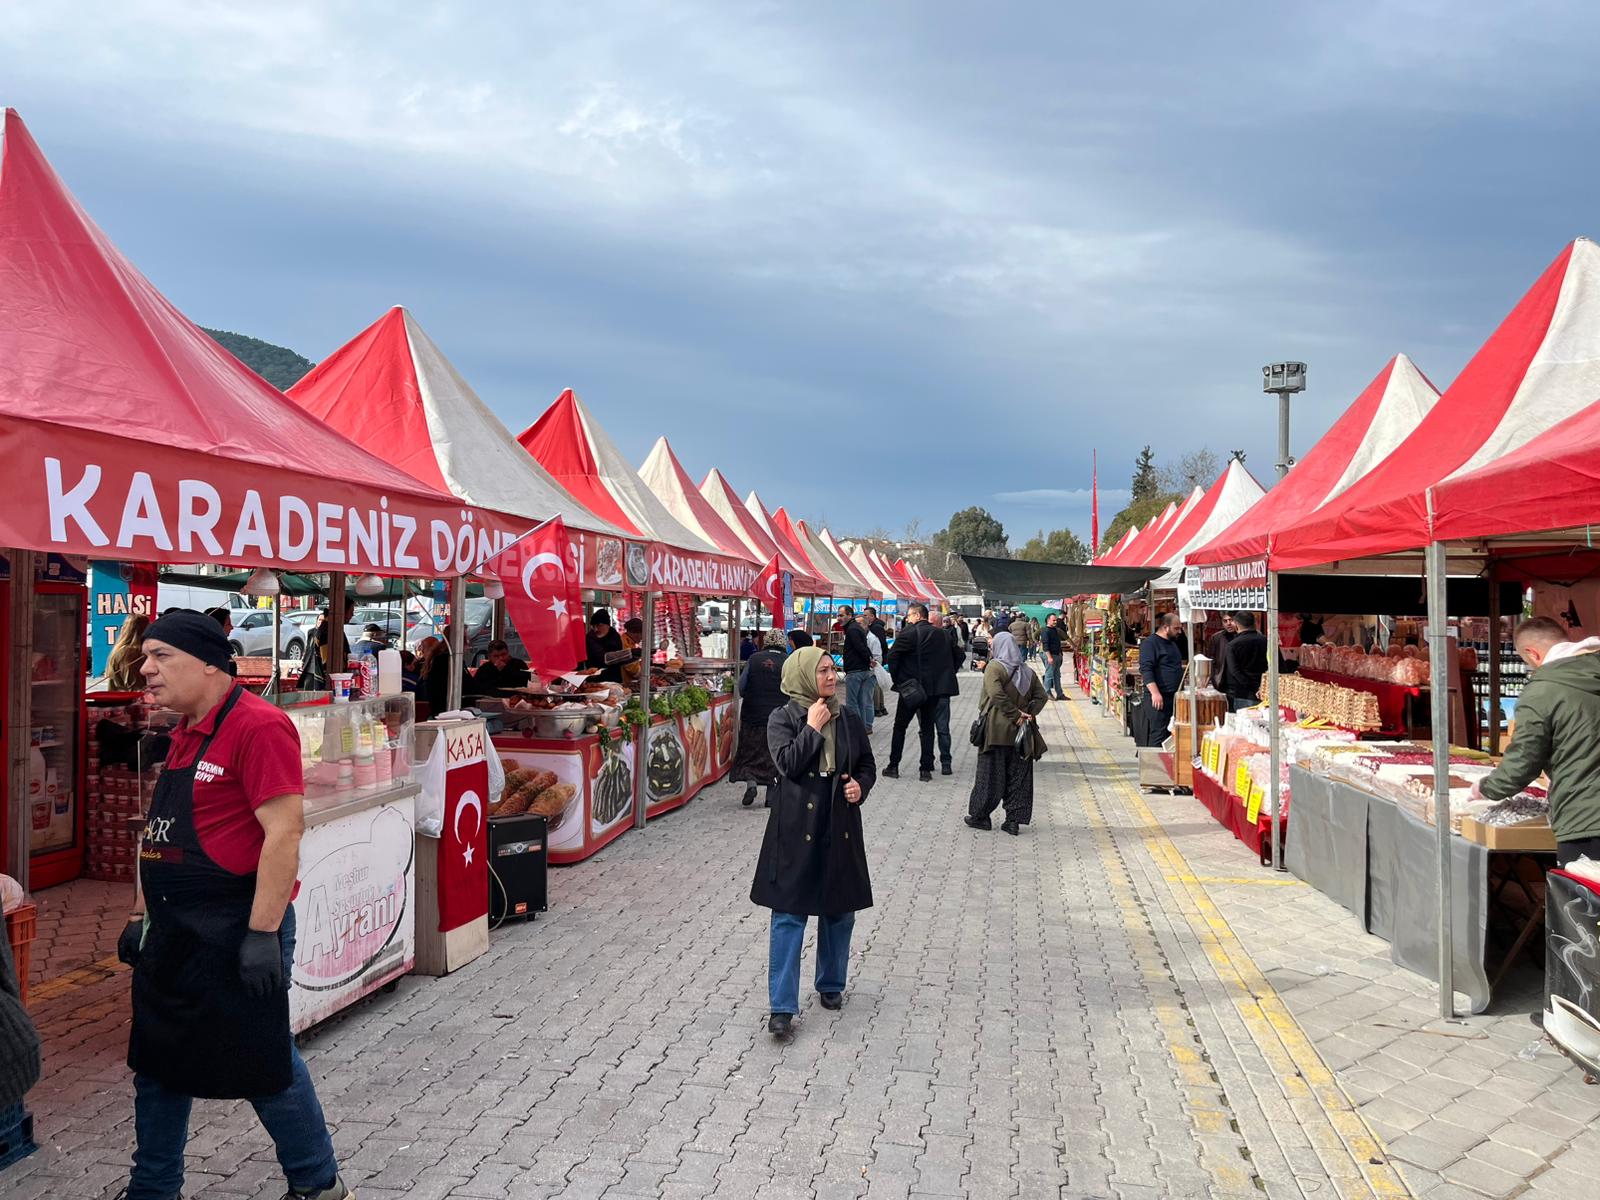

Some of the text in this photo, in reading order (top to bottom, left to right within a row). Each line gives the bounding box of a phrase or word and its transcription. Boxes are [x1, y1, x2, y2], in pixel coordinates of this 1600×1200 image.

[45, 457, 419, 569] KARADENİZ
[650, 551, 719, 590] KARADENİZ
[447, 732, 484, 763] KASA
